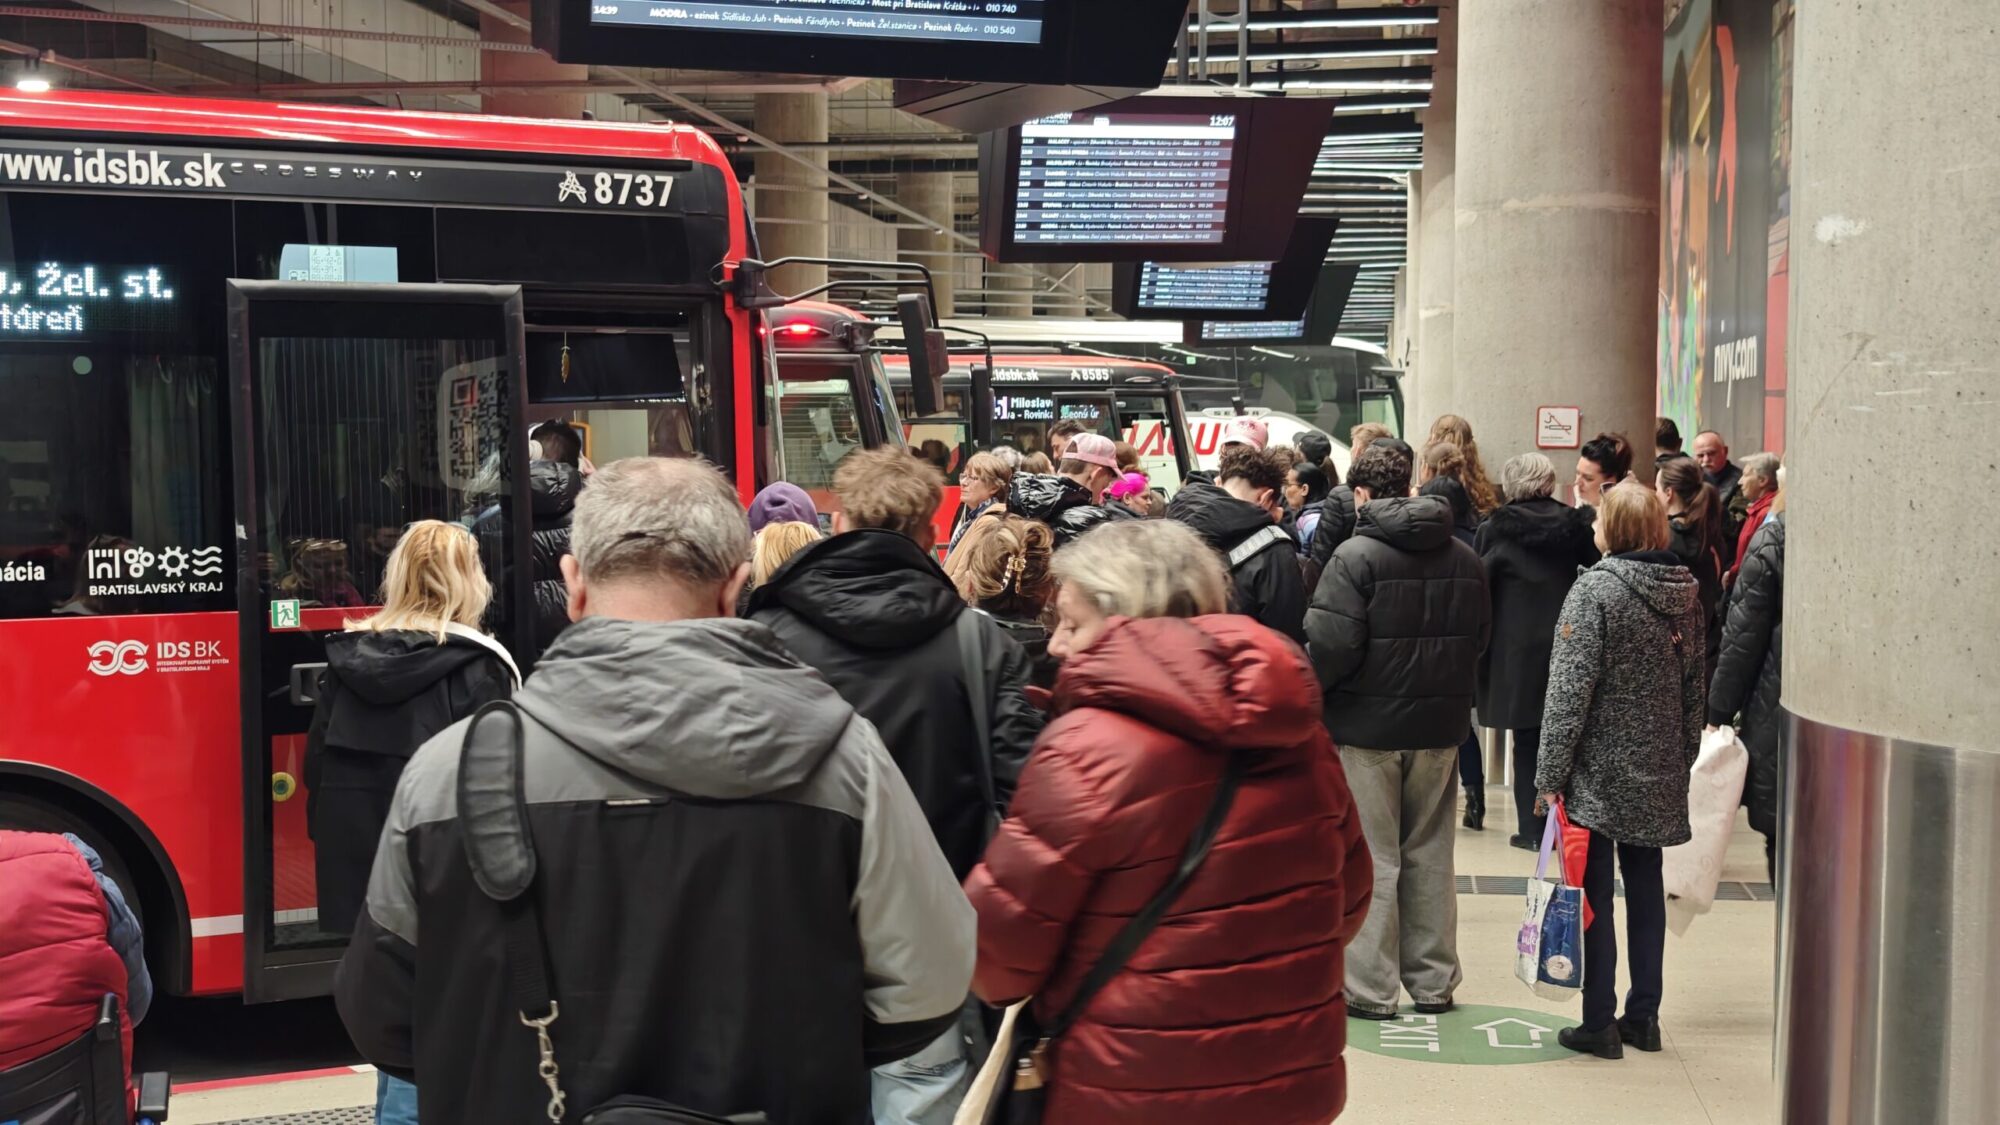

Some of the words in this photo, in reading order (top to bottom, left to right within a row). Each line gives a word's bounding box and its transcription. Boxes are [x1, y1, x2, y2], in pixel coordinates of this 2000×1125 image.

[986, 4, 1000, 13] 010
[1002, 4, 1017, 13] 740
[650, 8, 688, 19] MODRA
[984, 25, 998, 34] 010
[1000, 26, 1015, 35] 540
[1209, 114, 1235, 126] 12:07
[0, 147, 226, 188] ww.idsbk.sk
[594, 172, 674, 207] 8737
[38, 262, 109, 297] Žel.
[124, 267, 174, 298] st.
[1714, 320, 1757, 408] nivy.com
[991, 368, 1039, 381] .idsbk.sk
[1081, 368, 1109, 381] 8585
[1011, 397, 1053, 409] Miloslav
[89, 581, 186, 596] BRATISLAVSKÝ
[190, 582, 223, 592] KRAJ
[157, 642, 191, 659] IDS
[194, 641, 221, 658] BK
[1380, 1013, 1440, 1052] EXIT
